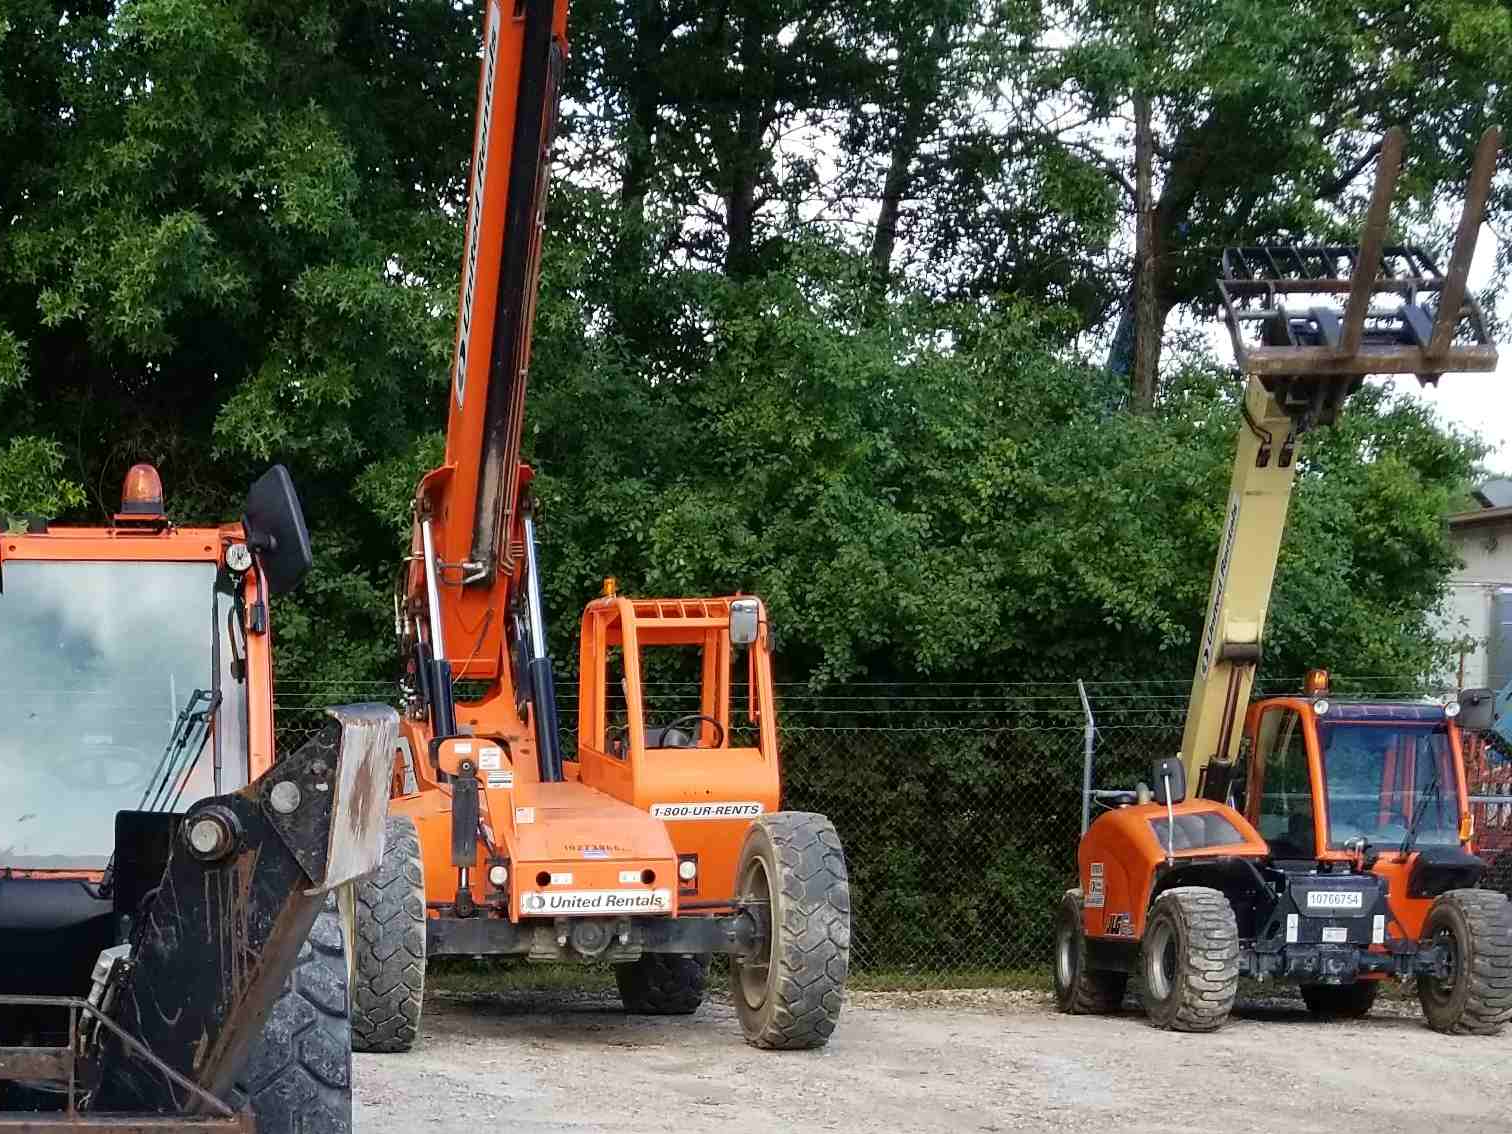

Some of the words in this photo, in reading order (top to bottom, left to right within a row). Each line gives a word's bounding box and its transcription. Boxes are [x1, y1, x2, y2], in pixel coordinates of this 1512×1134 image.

[654, 805, 759, 817] 1-800-UR-RENTS
[550, 895, 603, 909] United
[605, 892, 663, 907] Rentals
